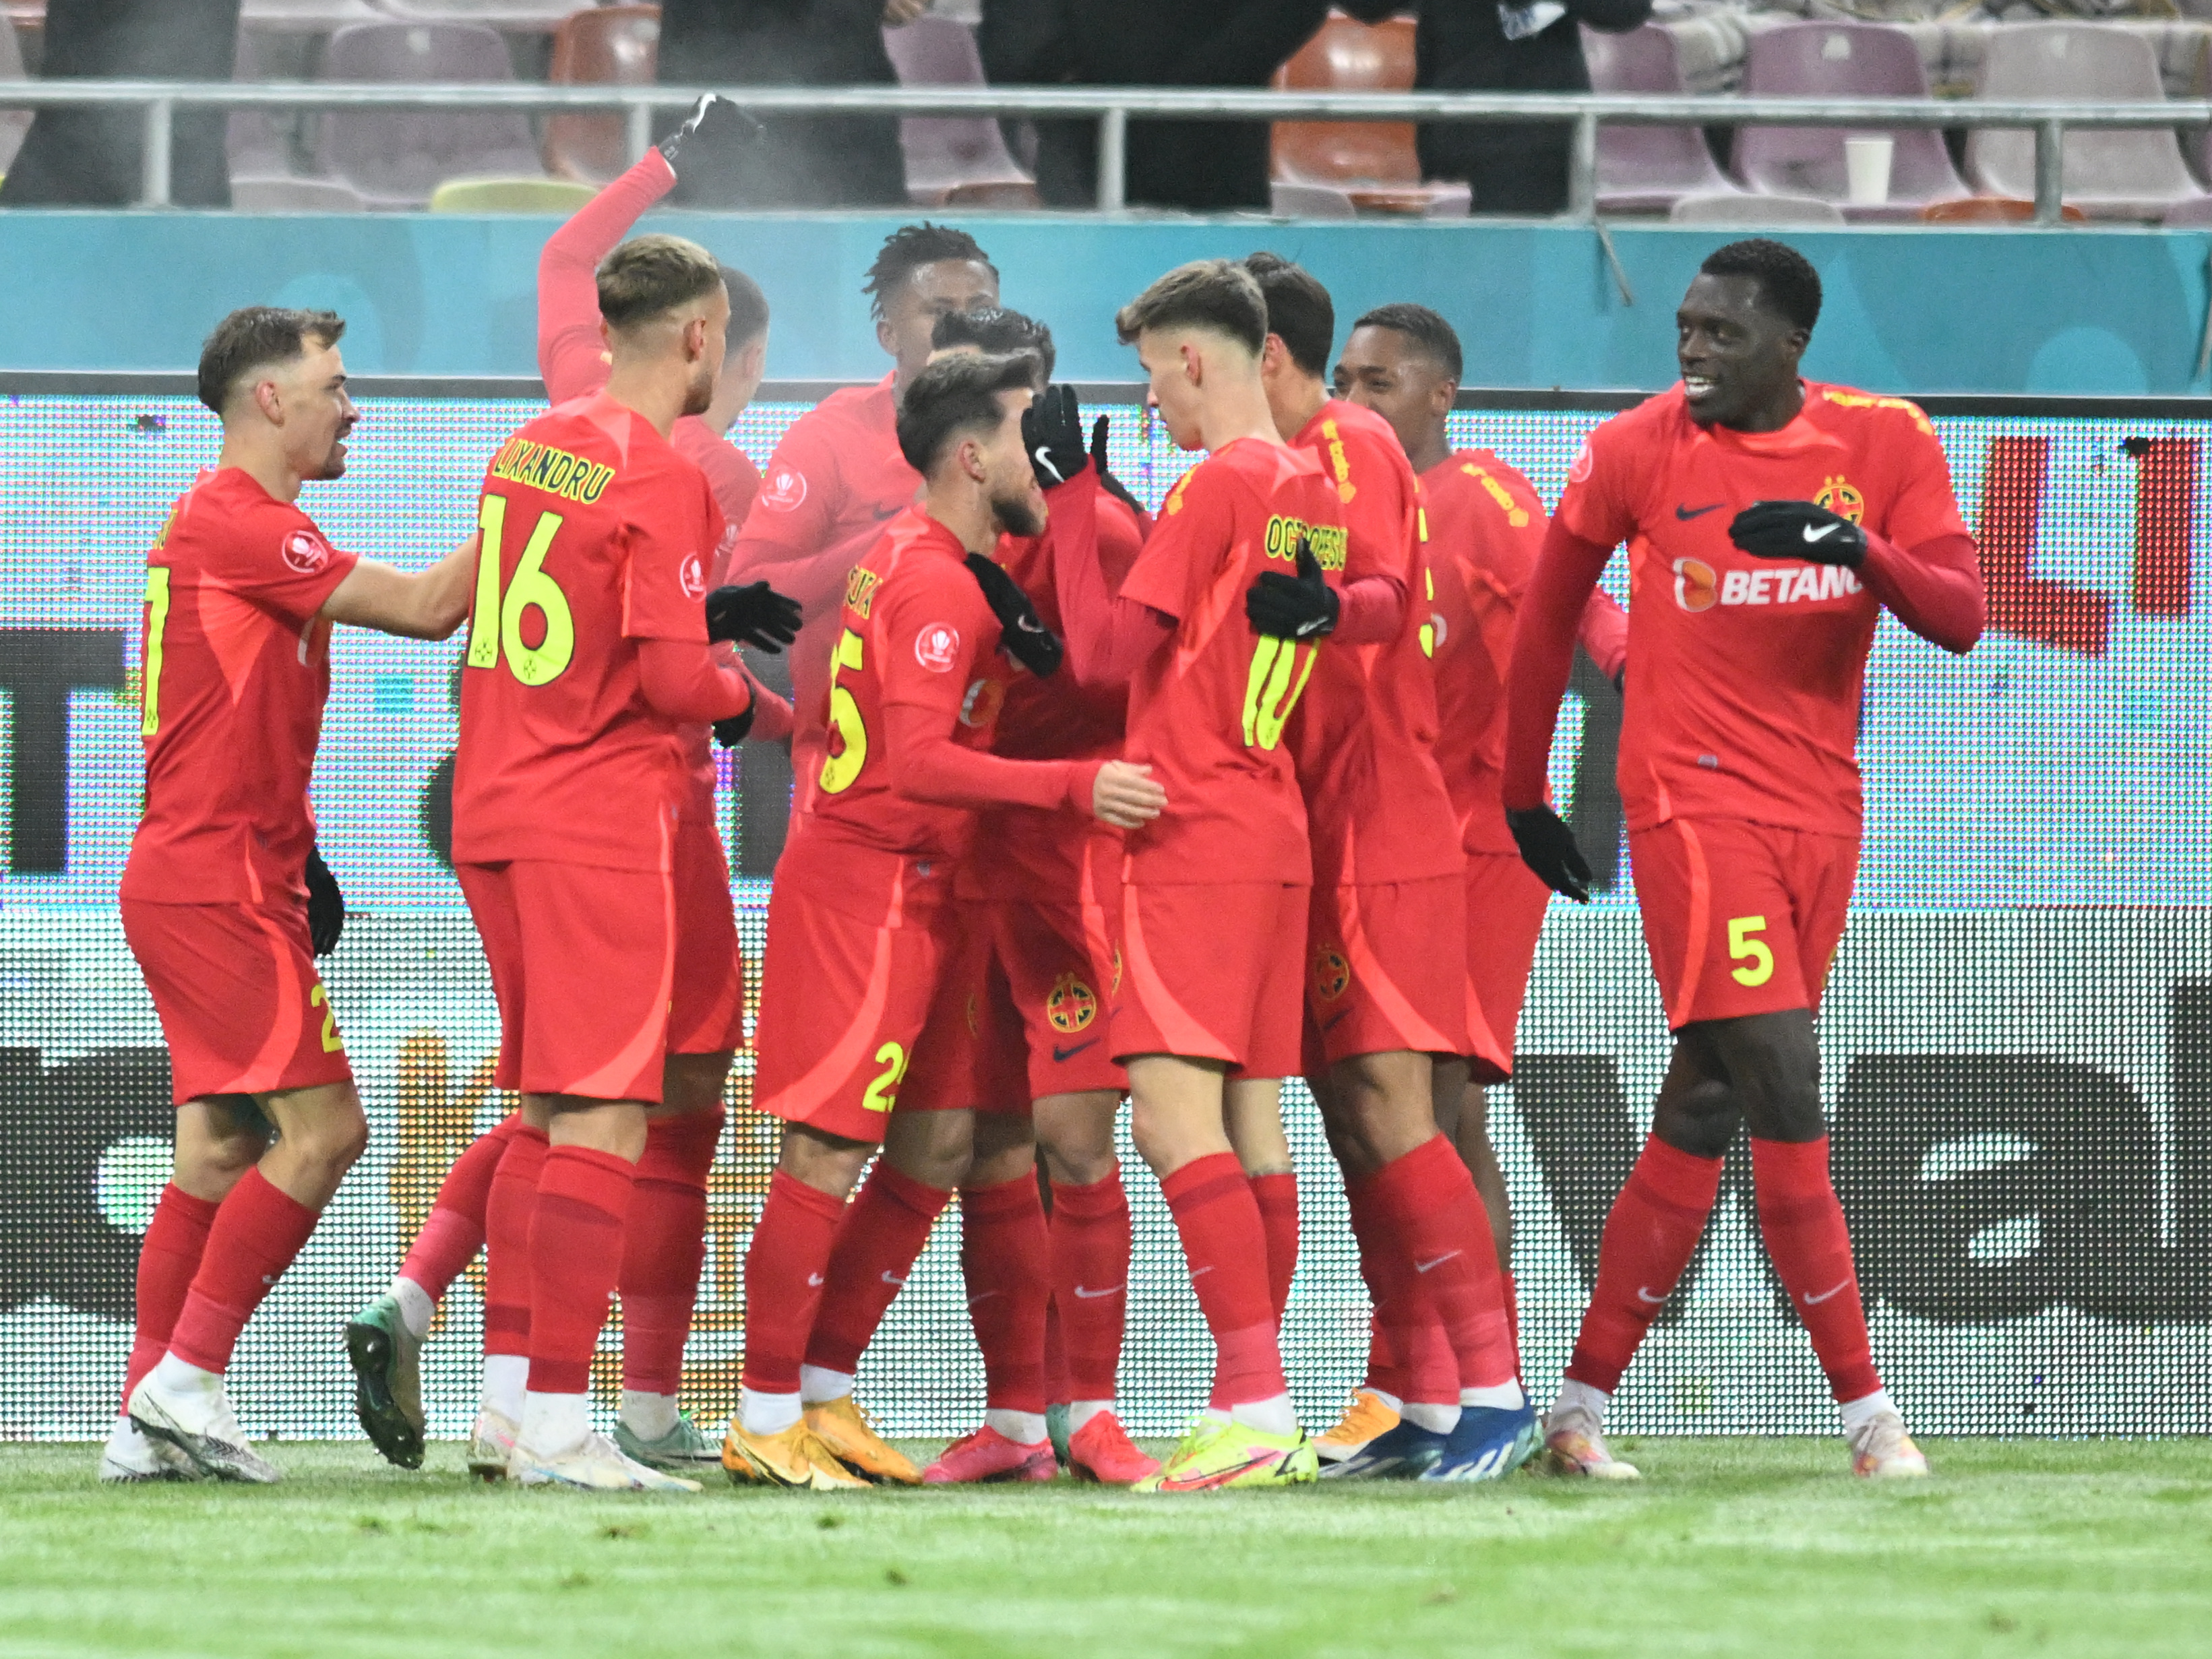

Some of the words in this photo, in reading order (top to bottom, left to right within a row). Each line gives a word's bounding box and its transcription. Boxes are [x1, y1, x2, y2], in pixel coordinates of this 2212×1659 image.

[493, 437, 615, 505] LIXANDRU
[467, 494, 575, 687] 16
[819, 626, 868, 795] 5
[1728, 915, 1774, 987] 5
